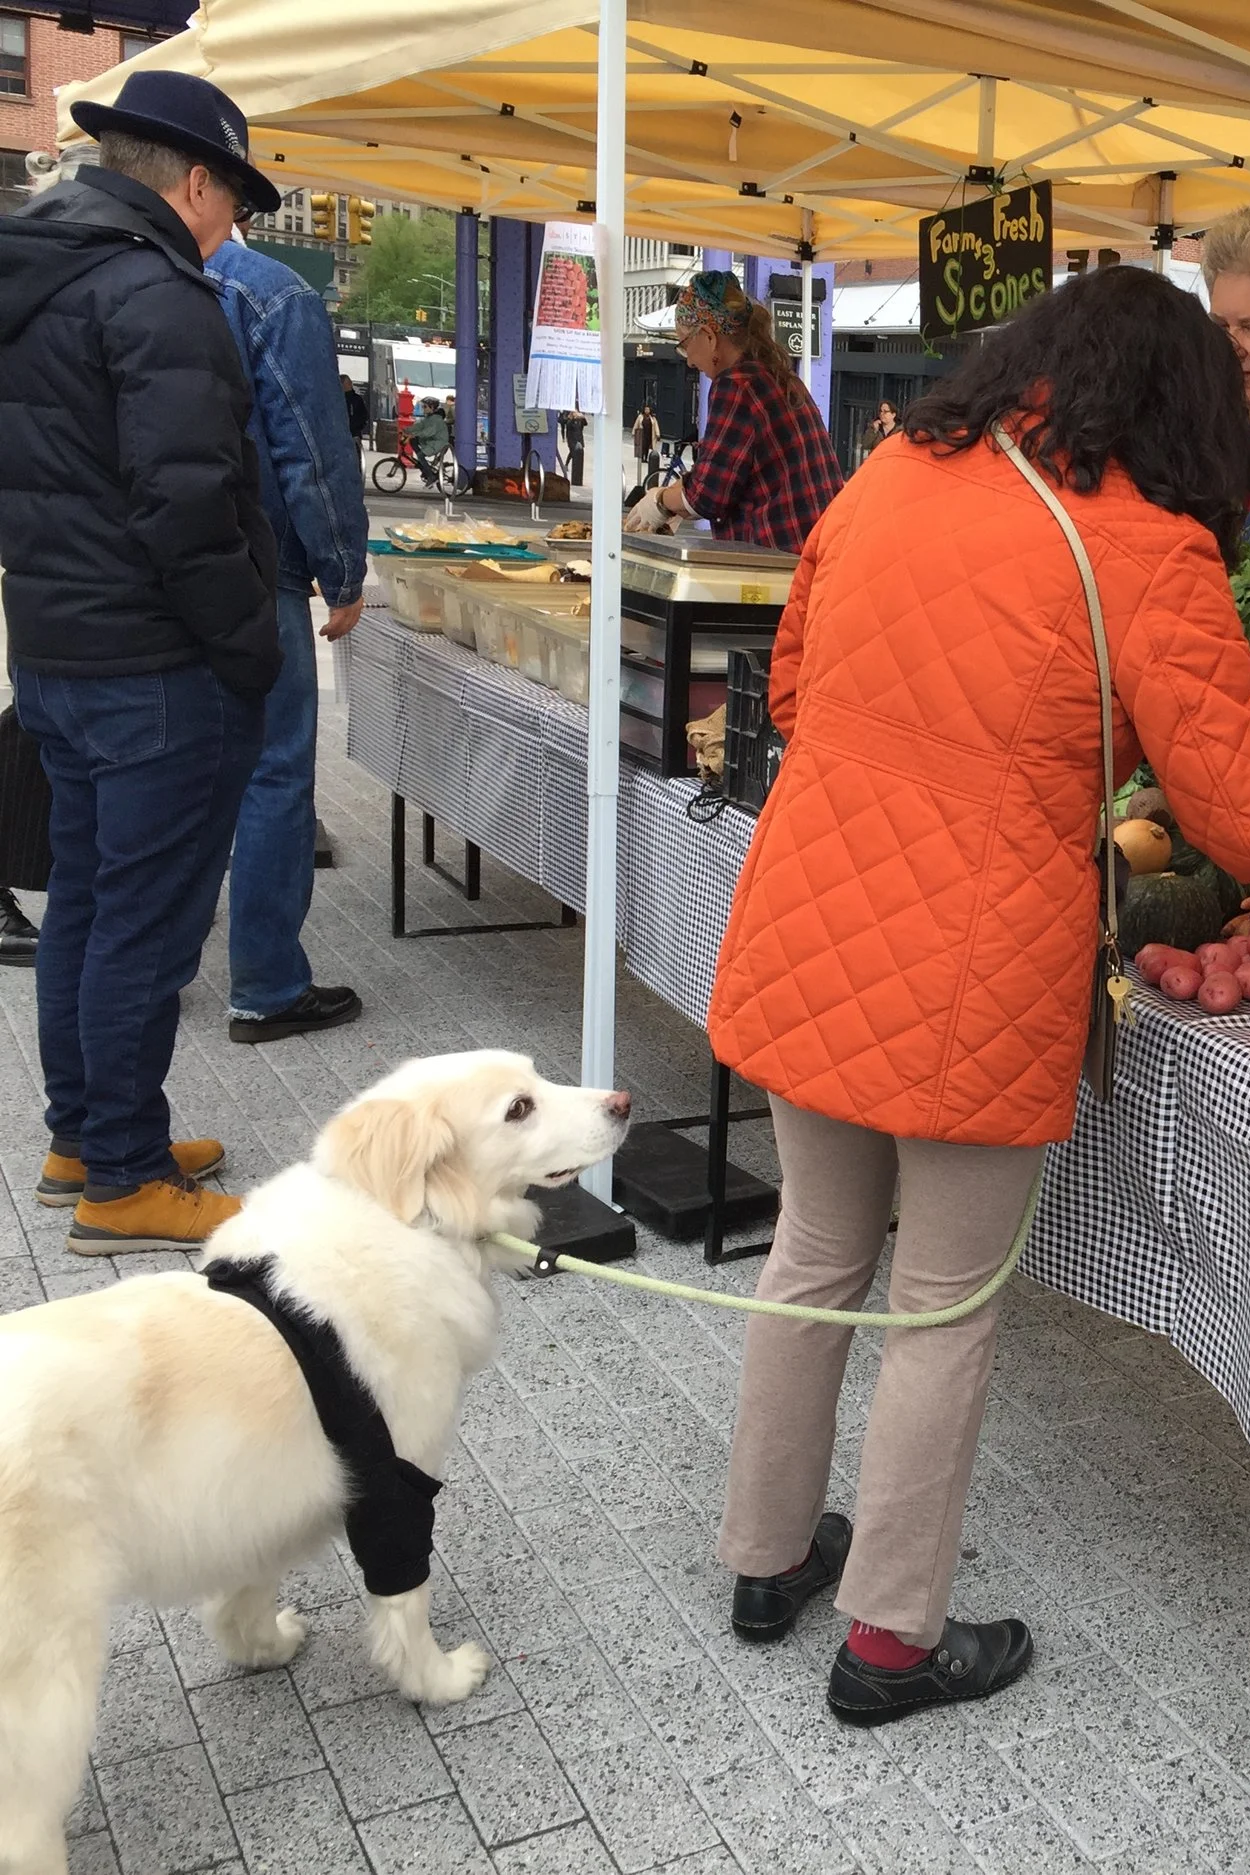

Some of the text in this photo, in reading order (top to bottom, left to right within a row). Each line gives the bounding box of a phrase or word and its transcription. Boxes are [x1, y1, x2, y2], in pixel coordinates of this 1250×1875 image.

[992, 194, 1045, 243] Fresh
[776, 310, 794, 318] EAST
[935, 258, 1046, 326] Scones
